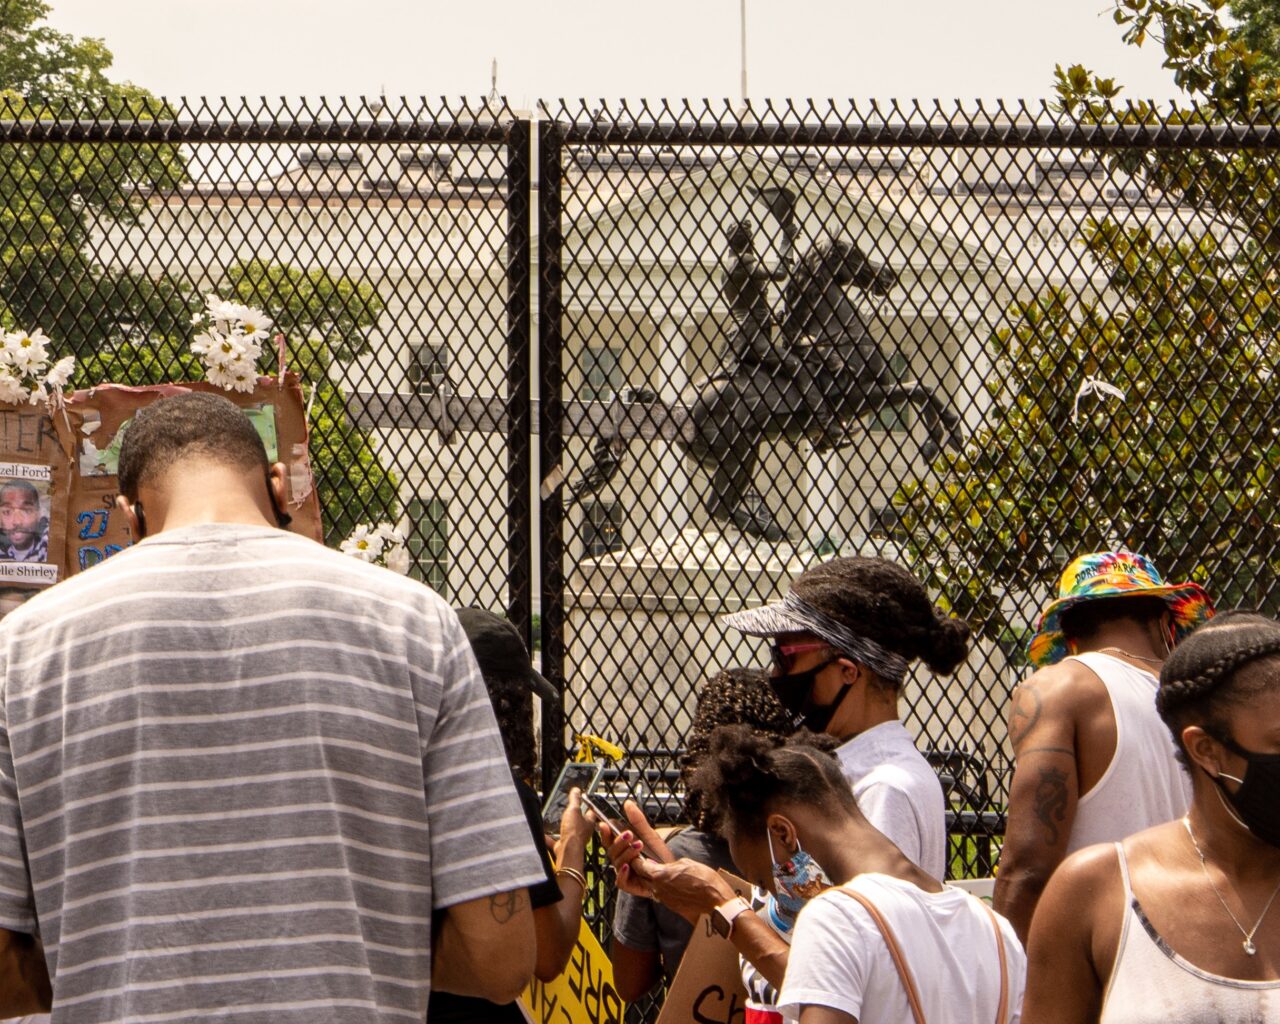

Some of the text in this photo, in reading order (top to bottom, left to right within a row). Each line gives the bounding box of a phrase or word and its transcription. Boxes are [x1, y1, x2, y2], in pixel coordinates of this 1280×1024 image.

[22, 466, 48, 478] Ford
[16, 566, 56, 580] Shirley
[1111, 561, 1137, 575] PARK
